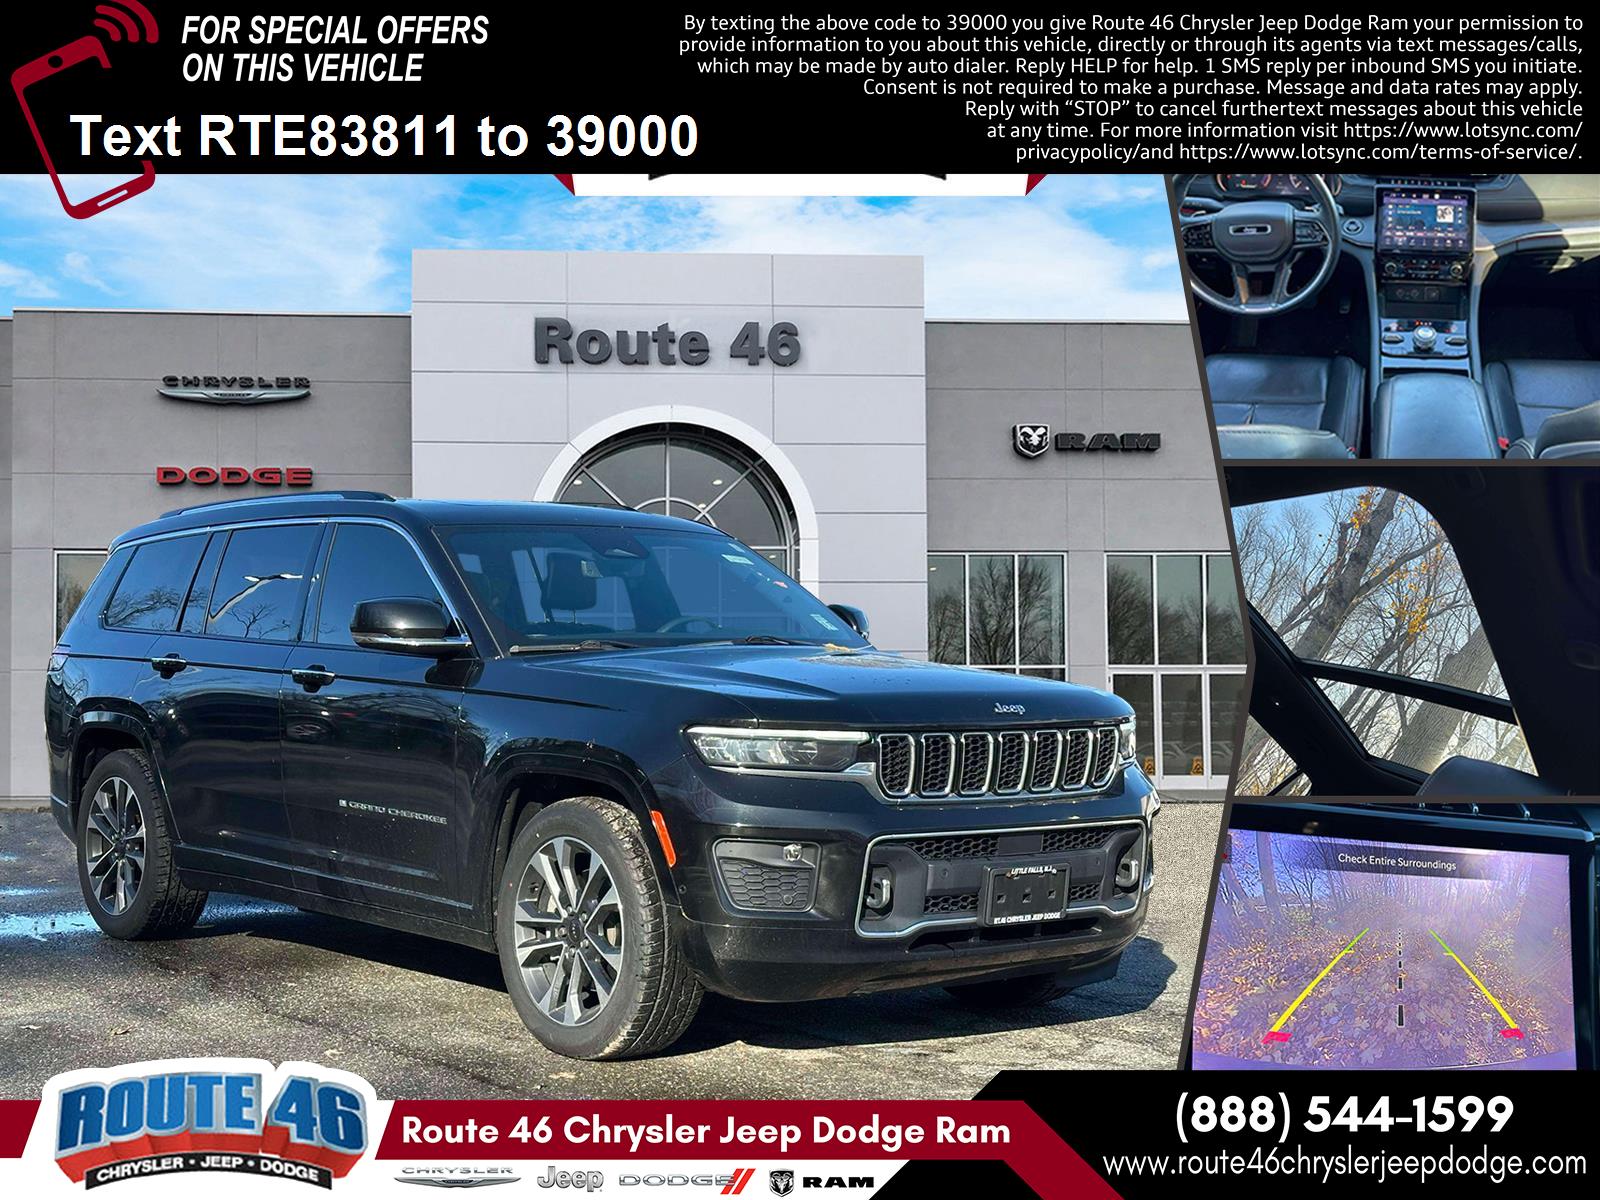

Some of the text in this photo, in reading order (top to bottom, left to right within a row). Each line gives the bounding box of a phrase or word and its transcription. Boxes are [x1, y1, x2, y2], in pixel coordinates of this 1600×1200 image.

[534, 317, 802, 367] Route 46
[162, 375, 311, 388] CHRYSLER
[1054, 432, 1161, 452] RAM
[156, 466, 313, 486] DODGE
[994, 702, 1026, 715] Jeep
[348, 800, 386, 814] GRAND
[388, 807, 447, 825] CHEROKEE
[1338, 853, 1457, 872] Check Entire Surroundings
